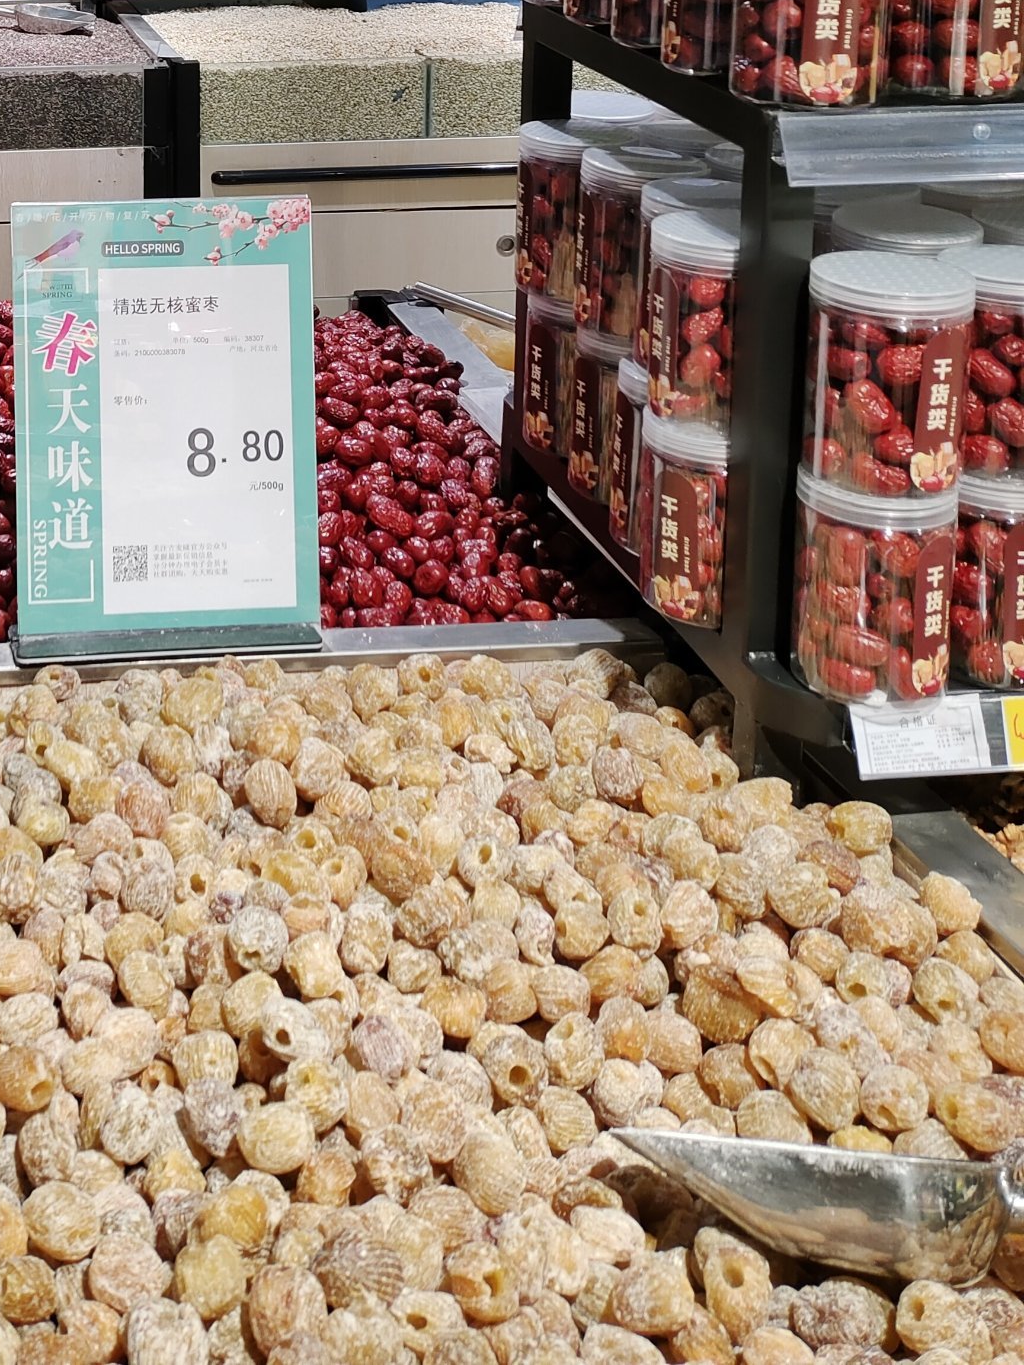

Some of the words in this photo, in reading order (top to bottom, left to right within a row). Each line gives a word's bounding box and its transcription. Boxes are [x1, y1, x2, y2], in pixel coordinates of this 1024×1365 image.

[843, 30, 851, 49] food
[845, 8, 853, 28] dried
[105, 244, 139, 254] HELLO
[142, 242, 180, 254] SPRING
[576, 213, 585, 271] 干货类
[113, 296, 219, 315] 精选无核蜜枣
[652, 293, 664, 360] 干货类
[531, 345, 542, 400] 干货类
[927, 358, 952, 431] 干货类
[32, 311, 97, 551] 春天味道
[576, 380, 586, 438] 干货类
[249, 479, 284, 491] 元/500g
[661, 494, 678, 562] 干货类
[33, 519, 47, 600] SPRING
[924, 565, 944, 637] 干货类
[899, 714, 937, 728] 合格证
